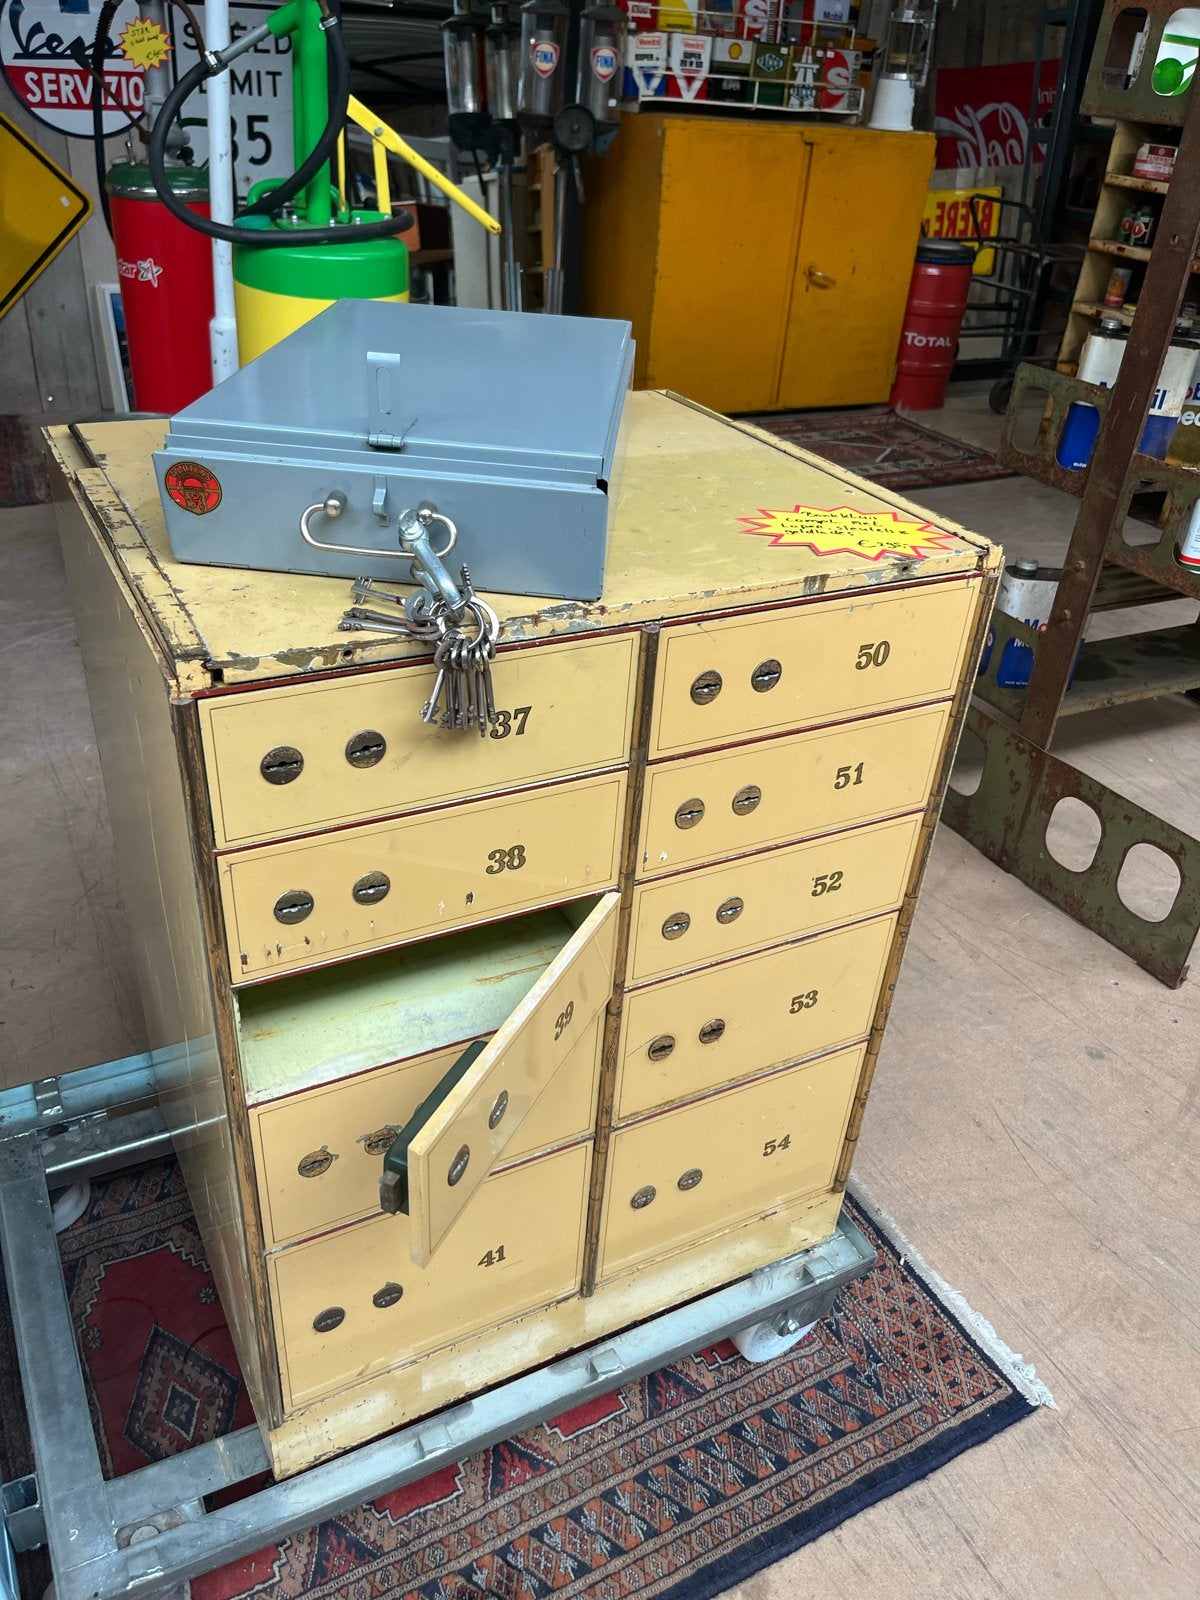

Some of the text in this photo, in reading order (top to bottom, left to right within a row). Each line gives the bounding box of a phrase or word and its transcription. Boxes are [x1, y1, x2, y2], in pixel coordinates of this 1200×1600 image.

[823, 11, 844, 20] Mobil
[536, 50, 554, 64] FINA
[596, 55, 614, 69] FINA
[25, 71, 145, 107] SERVZIO
[855, 641, 890, 670] 50
[490, 706, 532, 739] 37
[834, 762, 864, 789] 51
[486, 844, 526, 874] 38
[811, 870, 843, 897] 52
[789, 990, 818, 1014] 53
[554, 1000, 574, 1041] 39
[763, 1134, 791, 1157] 54
[477, 1245, 506, 1267] 41
